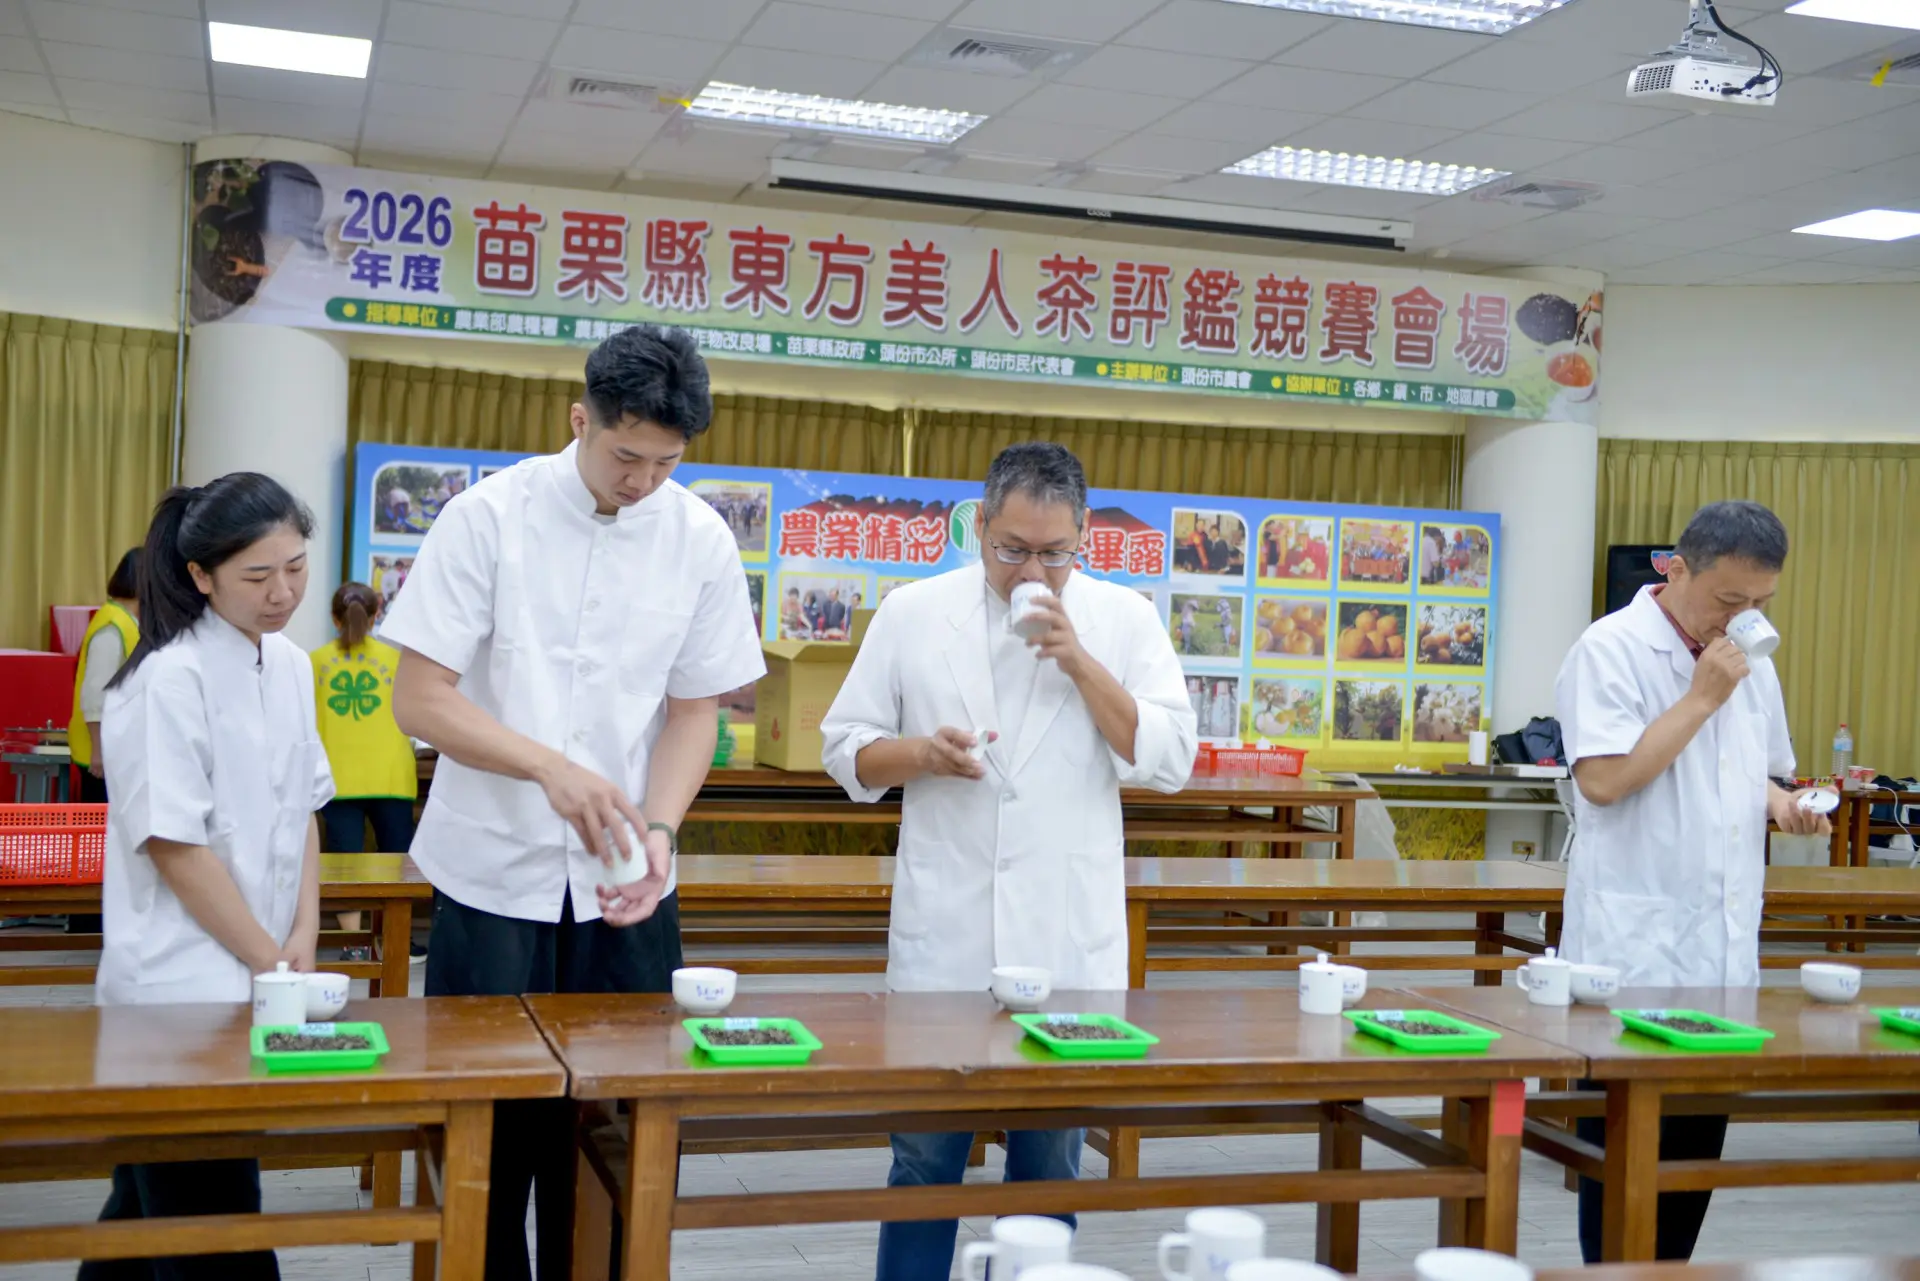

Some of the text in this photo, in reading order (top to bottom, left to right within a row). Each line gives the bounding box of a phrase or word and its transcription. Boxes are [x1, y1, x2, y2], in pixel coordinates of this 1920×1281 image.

[341, 188, 452, 247] 2026
[351, 250, 441, 293] 年度
[472, 200, 1511, 374] 苗栗縣東方美人茶評鑑競賽會場
[778, 510, 1166, 576] 農業精彩 畢露
